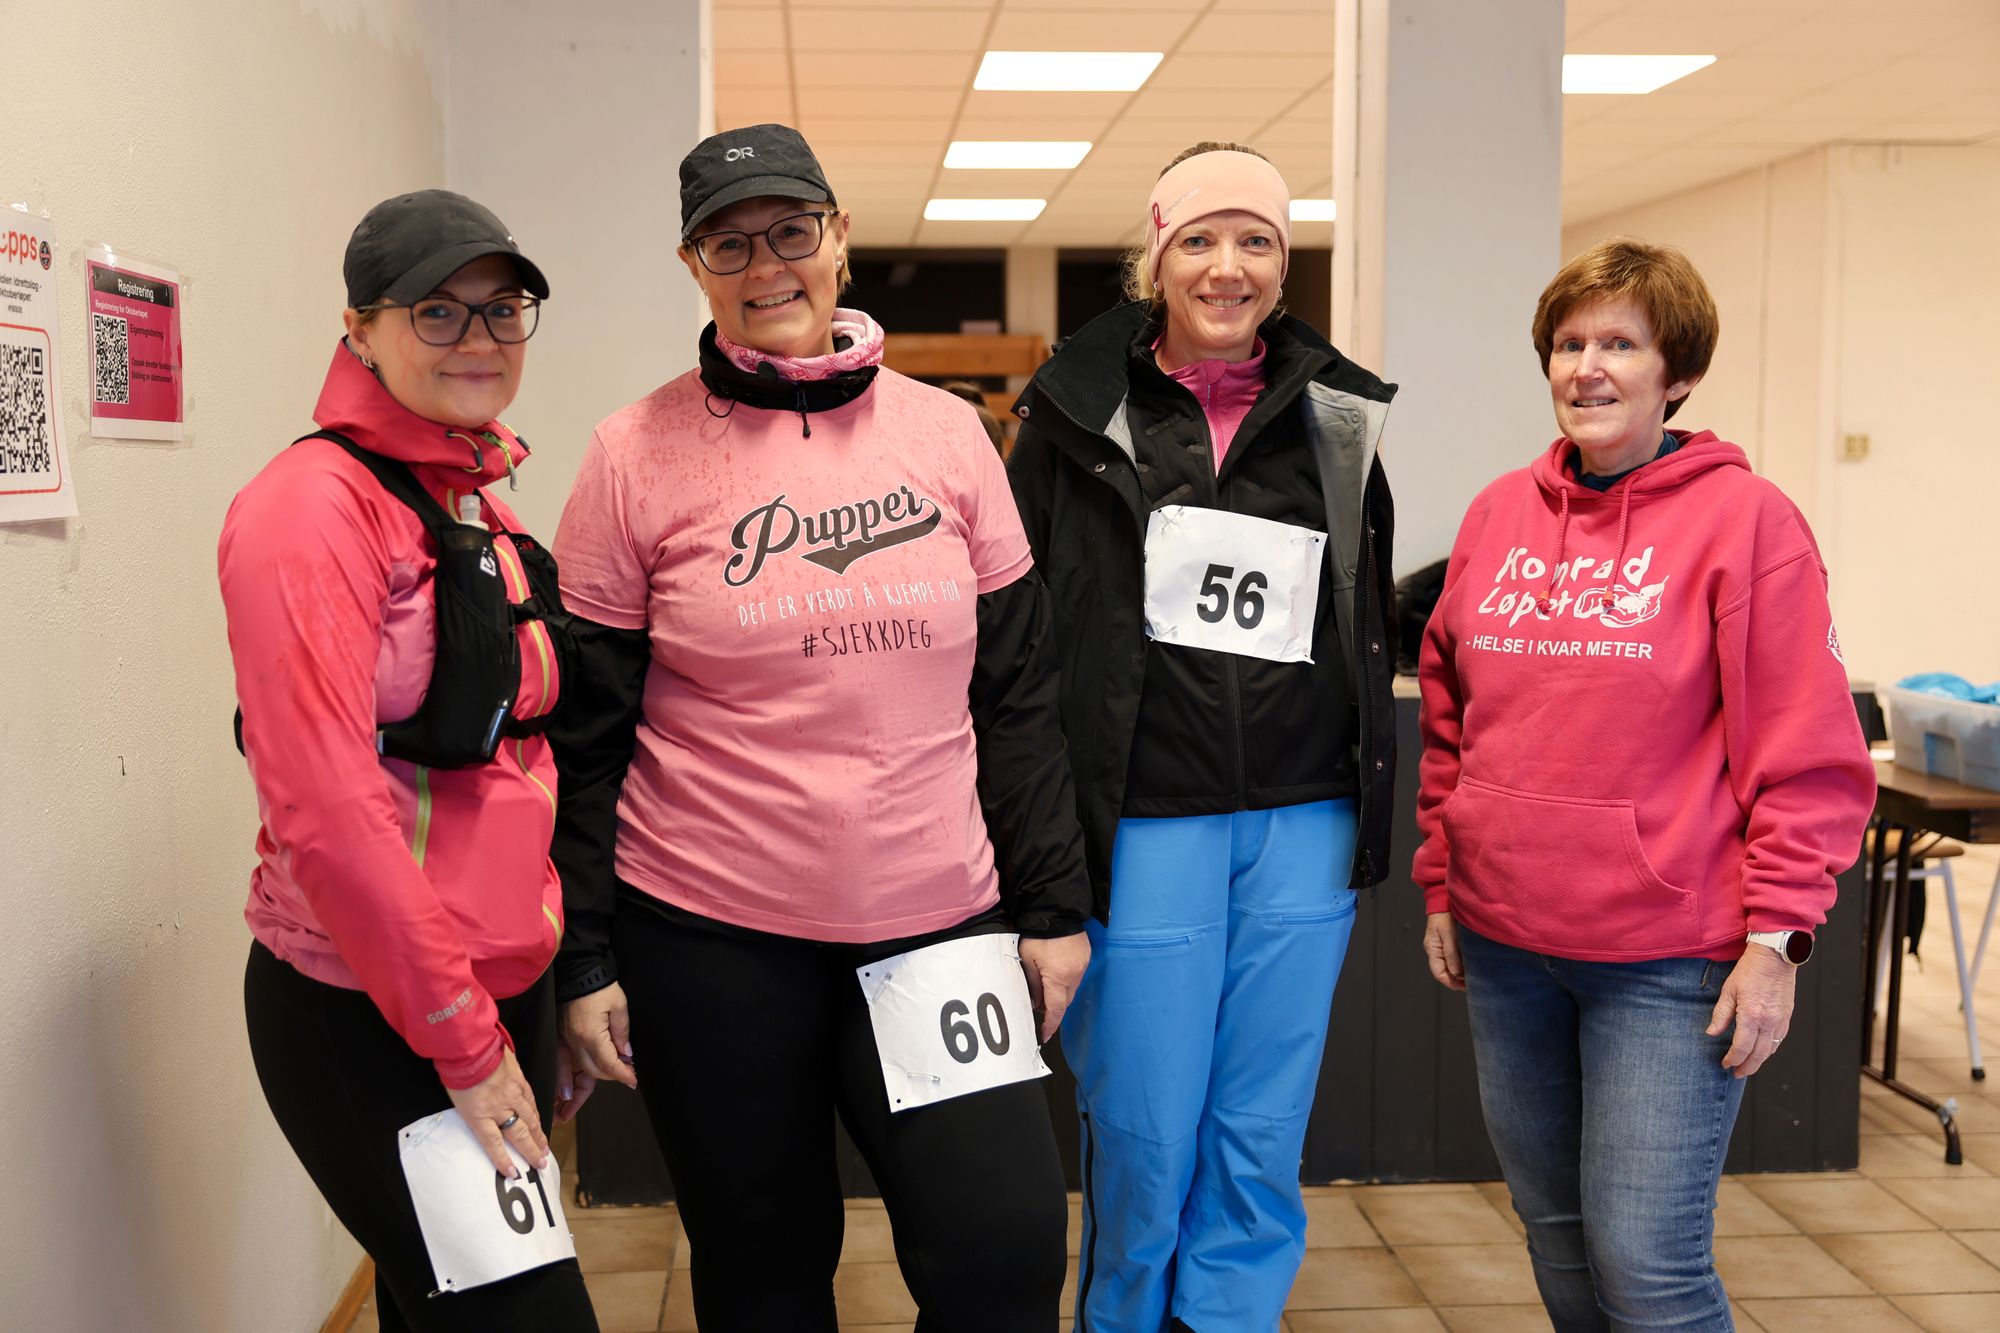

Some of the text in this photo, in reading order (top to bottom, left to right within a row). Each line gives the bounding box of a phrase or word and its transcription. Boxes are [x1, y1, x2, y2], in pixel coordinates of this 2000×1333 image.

[724, 146, 755, 162] OR
[117, 278, 154, 303] Registrering
[723, 485, 926, 587] Pupper
[1494, 545, 1654, 588] Konrad
[738, 601, 767, 627] DET
[777, 594, 798, 619] ER
[805, 587, 856, 614] VERDT
[863, 582, 876, 608] Å
[883, 583, 938, 606] KJEMPE
[1196, 563, 1268, 630] 56
[801, 619, 931, 658] #SJEKKDEG
[1472, 634, 1525, 655] HELSE
[1527, 639, 1534, 655] I
[1536, 639, 1582, 657] KVAR
[1586, 641, 1653, 660] METER
[940, 992, 1010, 1064] 60
[495, 1165, 556, 1234] 61
